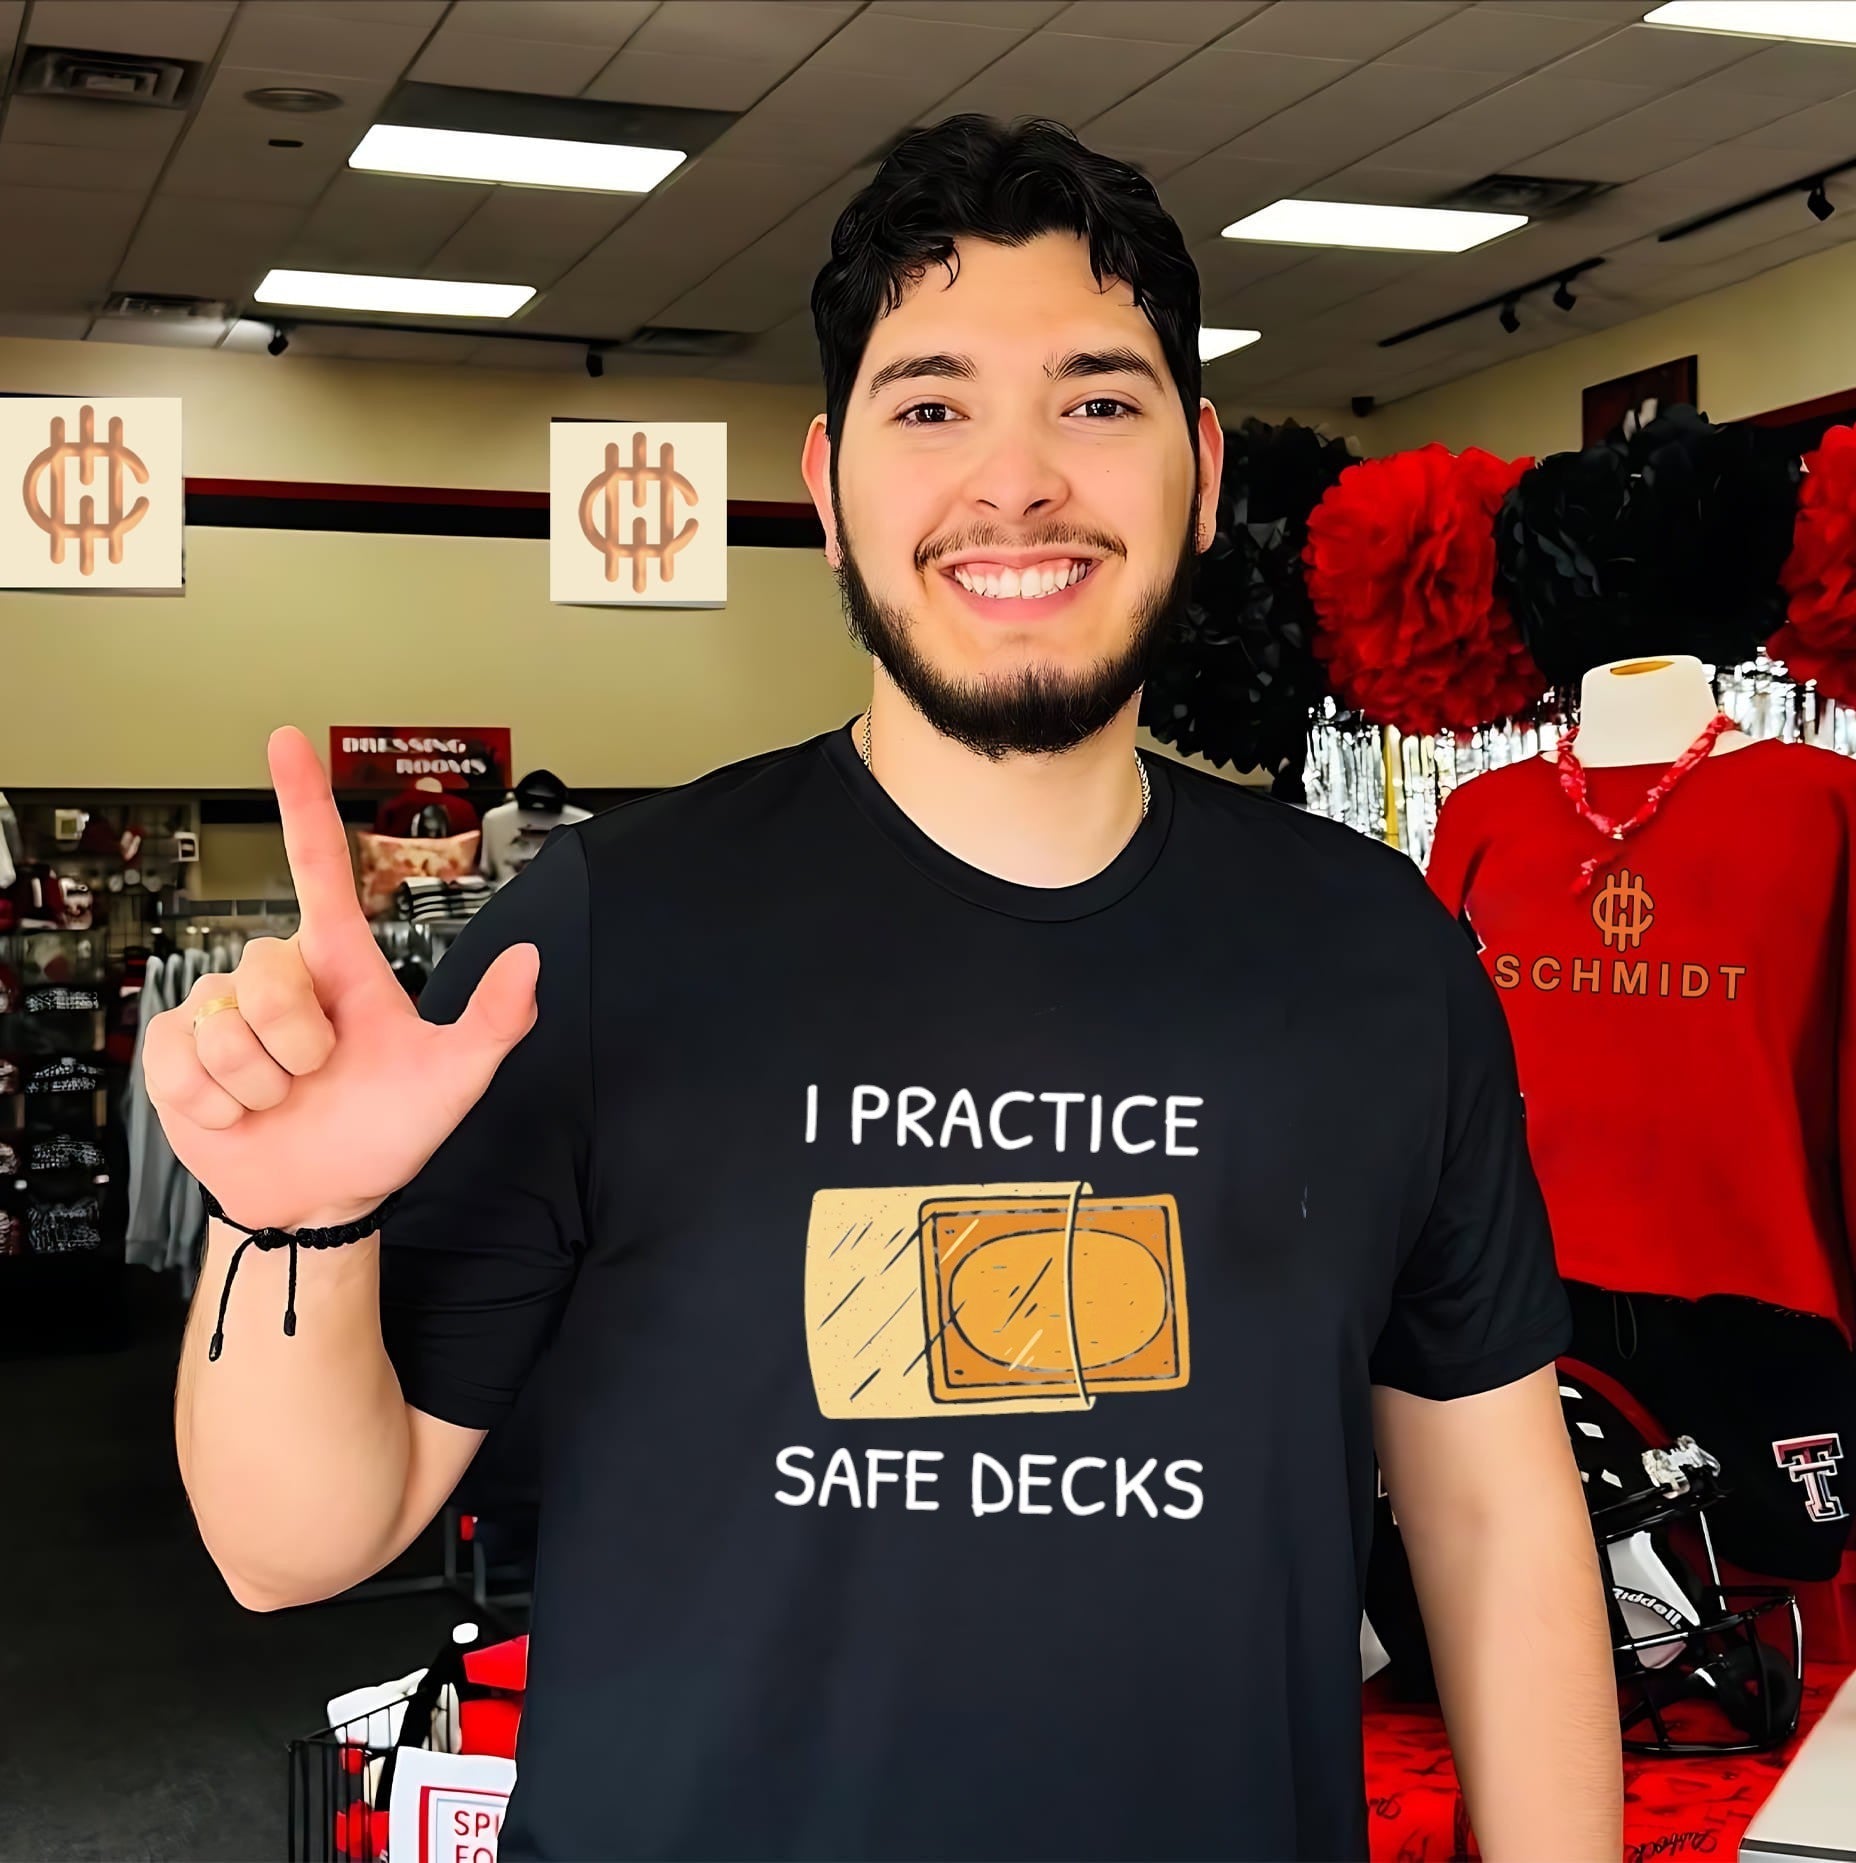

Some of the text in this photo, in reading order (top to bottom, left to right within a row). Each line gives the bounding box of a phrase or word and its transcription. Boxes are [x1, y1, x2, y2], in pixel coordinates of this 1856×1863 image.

[396, 758, 487, 775] ROOMS
[1493, 953, 1747, 1001] SCHMIDT
[805, 1084, 1204, 1157] I PRACTICE
[774, 1445, 1204, 1520] SAFE DECKS
